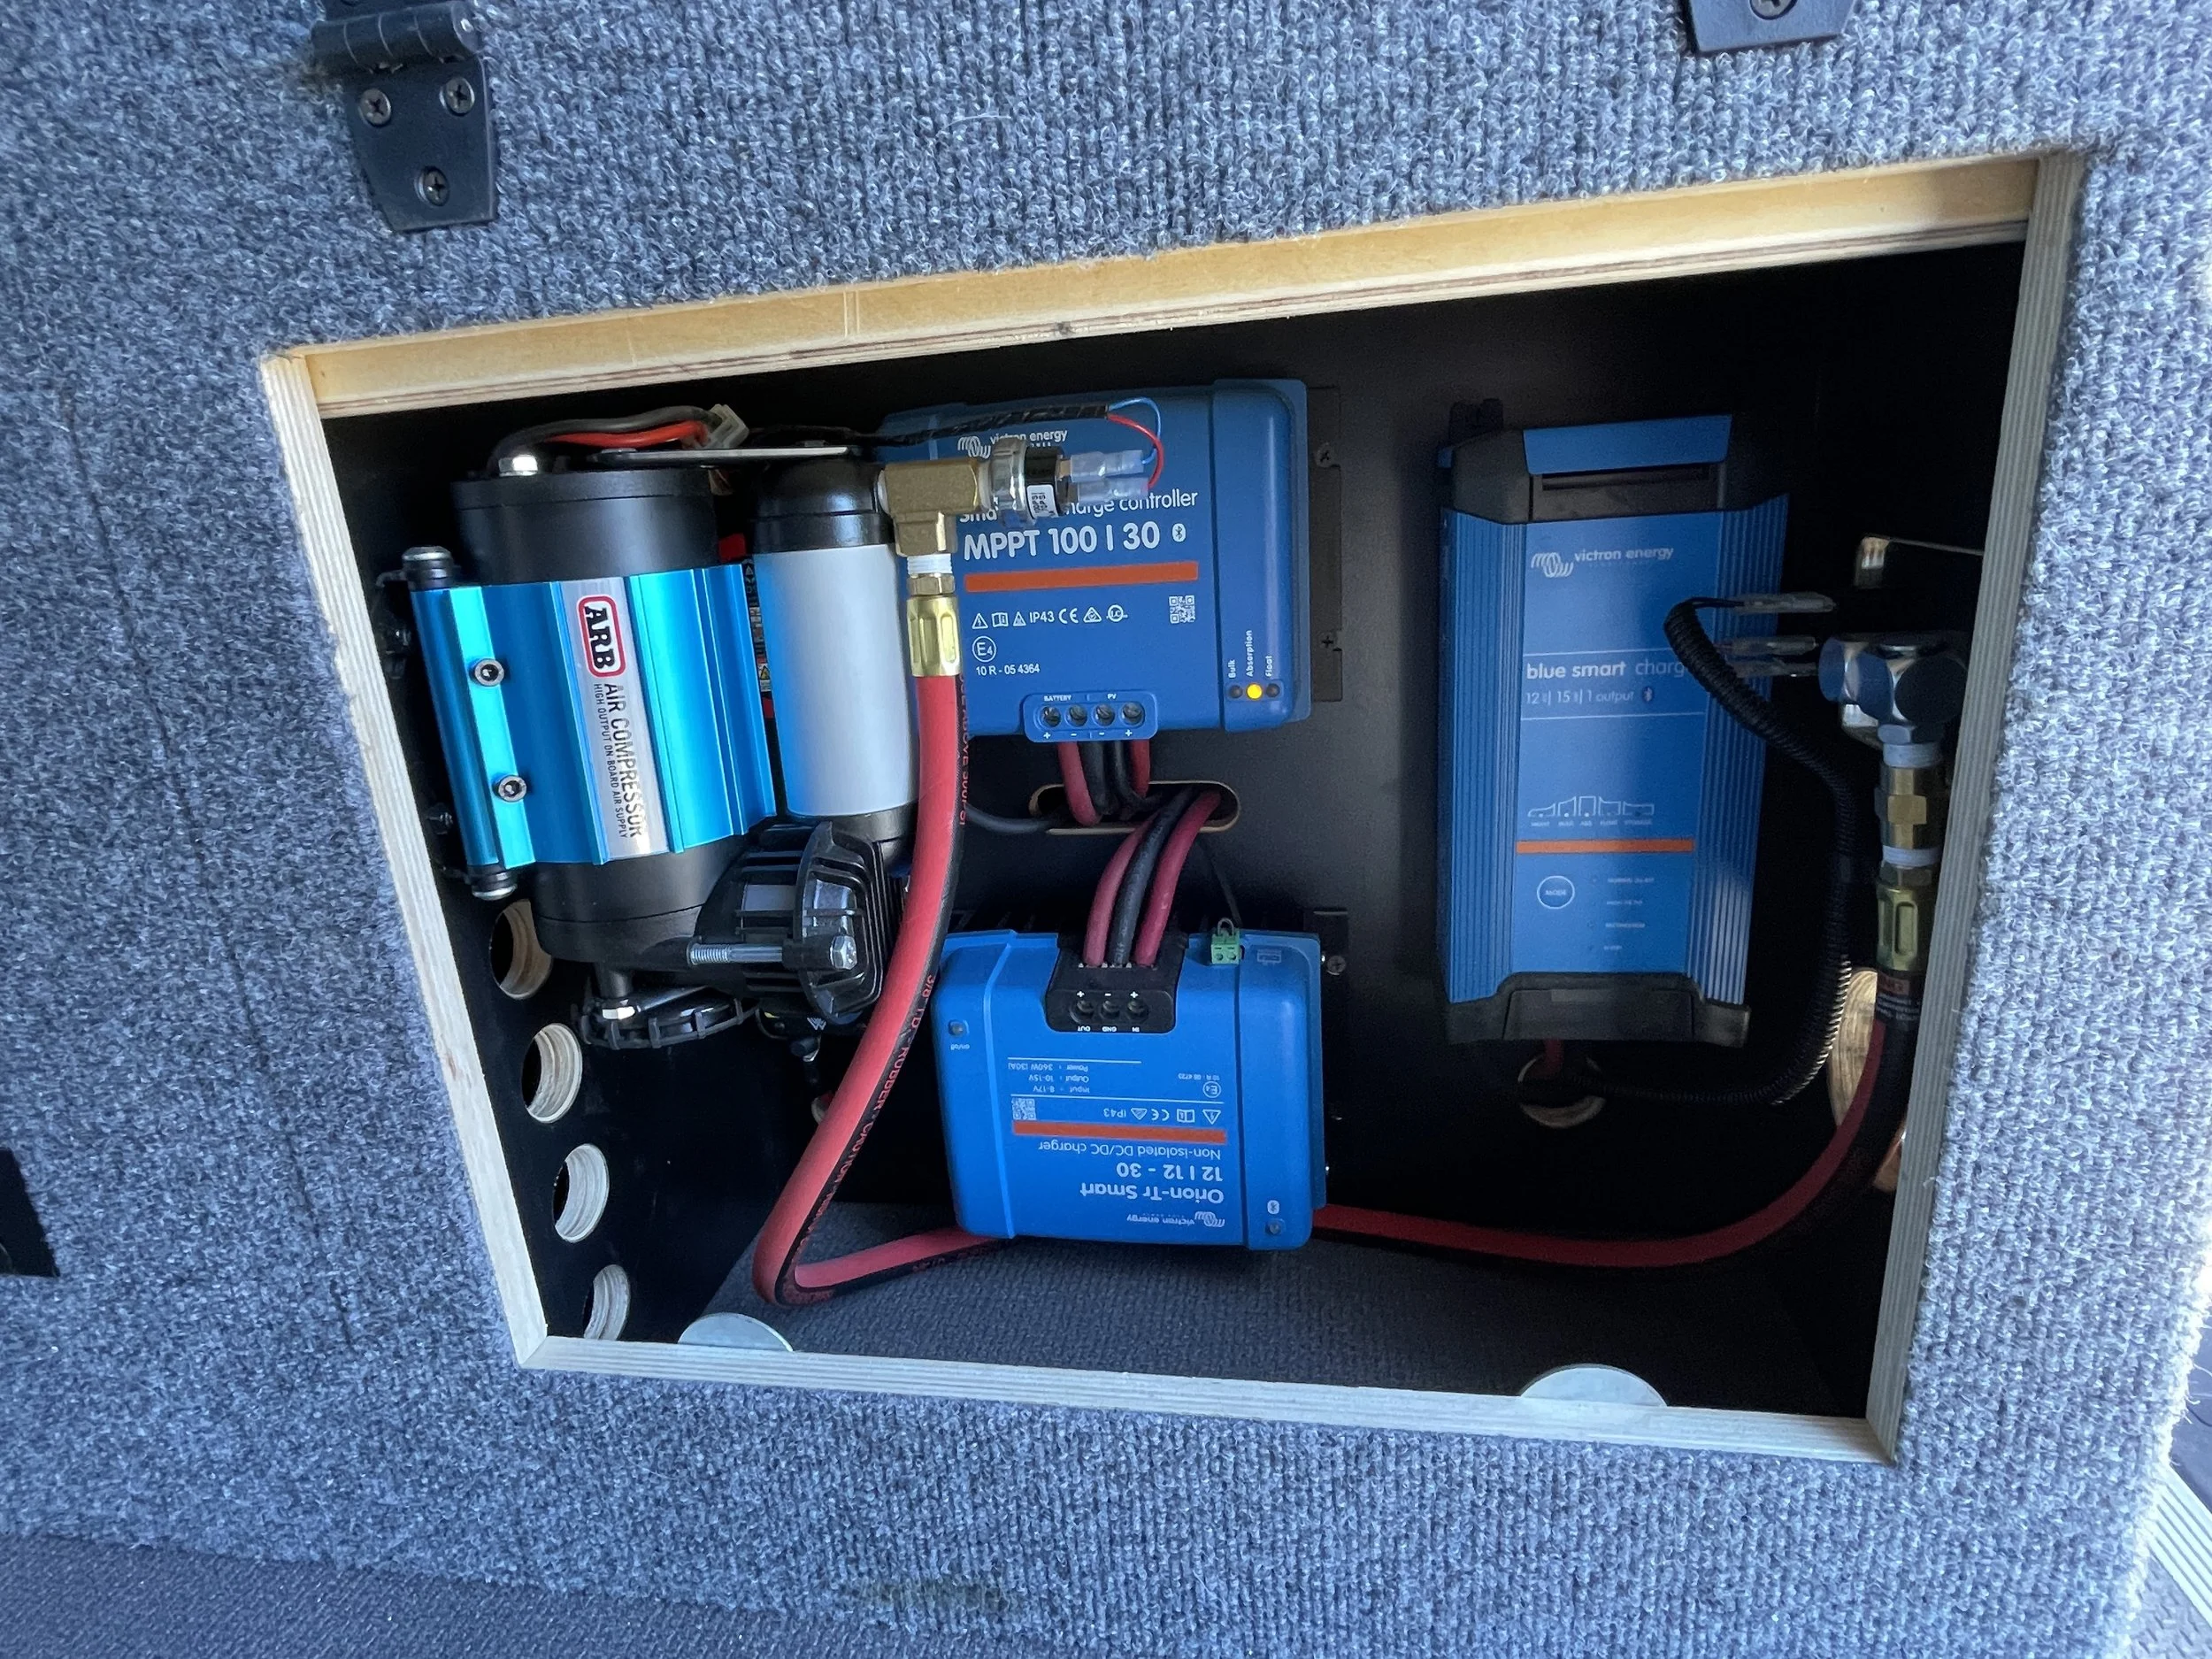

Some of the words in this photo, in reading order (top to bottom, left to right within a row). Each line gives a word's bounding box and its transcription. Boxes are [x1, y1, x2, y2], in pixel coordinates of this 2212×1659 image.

[1029, 430, 1067, 442] energy
[1119, 488, 1198, 511] controller
[964, 529, 1040, 561] MPPT
[1048, 526, 1097, 555] 100
[1123, 520, 1160, 550] 30
[1574, 549, 1622, 562] victron
[1625, 548, 1674, 560] energy
[1029, 610, 1055, 624] IP43
[584, 605, 616, 670] ARB
[1244, 629, 1255, 678] Absorption
[976, 665, 987, 676] 10
[988, 665, 997, 676] R
[1004, 664, 1016, 675] 05
[1018, 664, 1041, 674] 4364
[1227, 659, 1236, 679] Bulk
[1526, 662, 1566, 680] blue
[1571, 660, 1626, 677] smart
[1635, 658, 1687, 678] charg
[594, 683, 605, 706] HIGH
[603, 683, 626, 713] AIR
[1596, 690, 1636, 704] output
[597, 709, 613, 742] OUTPUT
[603, 744, 619, 788] ON-BOARD
[611, 718, 644, 838] COMPRESSOR
[611, 790, 622, 804] AIR
[615, 807, 629, 839] SUPPLY
[1102, 1108, 1126, 1118] IP43
[1038, 1139, 1087, 1154] charger
[1090, 1143, 1133, 1156] DC/DC
[1138, 1145, 1221, 1160] Non-isolated
[1116, 1162, 1141, 1179] 30
[1164, 1164, 1184, 1179] 12
[1202, 1165, 1224, 1182] 12
[1079, 1182, 1138, 1200] Smart
[1142, 1186, 1225, 1204] Orion-Tr
[1126, 1214, 1160, 1224] energy
[1163, 1216, 1194, 1225] victron
